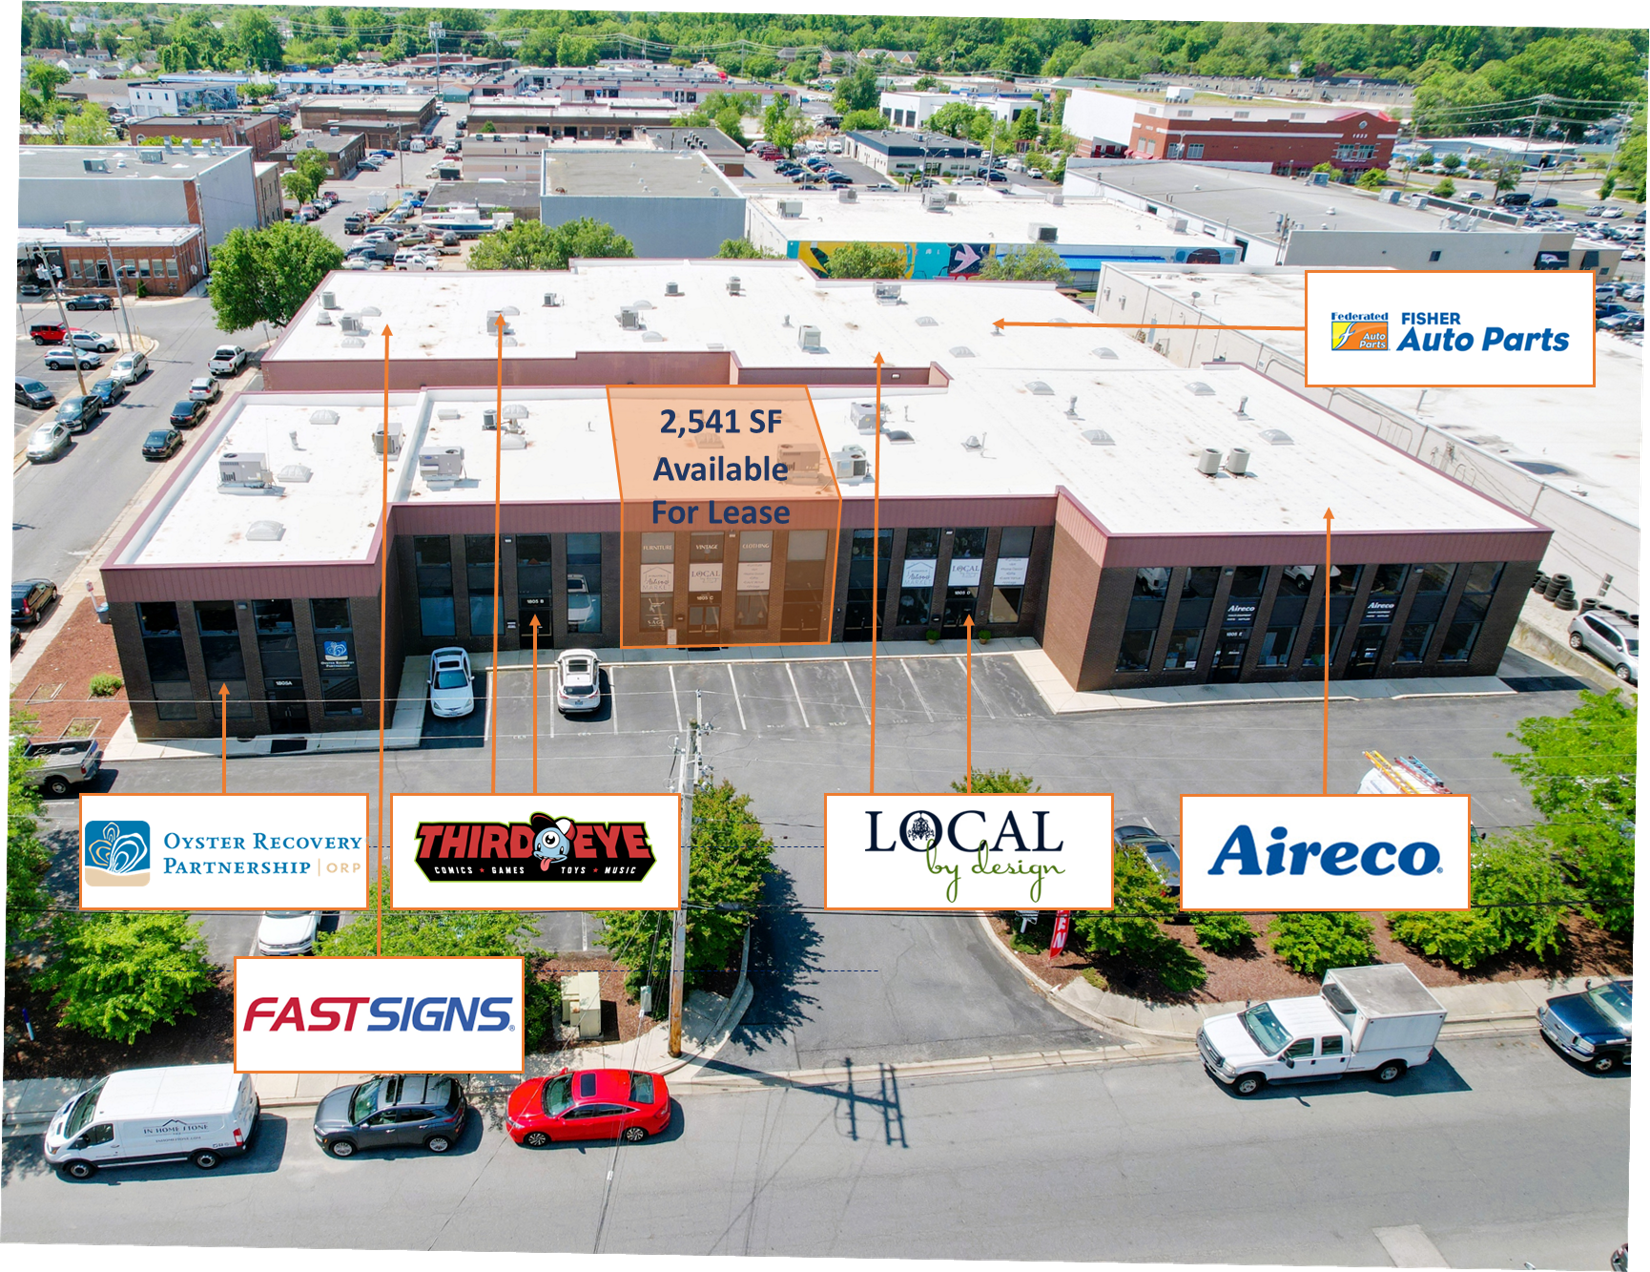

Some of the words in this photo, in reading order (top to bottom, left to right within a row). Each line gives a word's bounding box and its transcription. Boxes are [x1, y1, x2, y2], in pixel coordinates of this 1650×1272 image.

[691, 570, 720, 578] LOCAL
[1227, 604, 1256, 612] Aireco
[1367, 601, 1396, 609] Aireco
